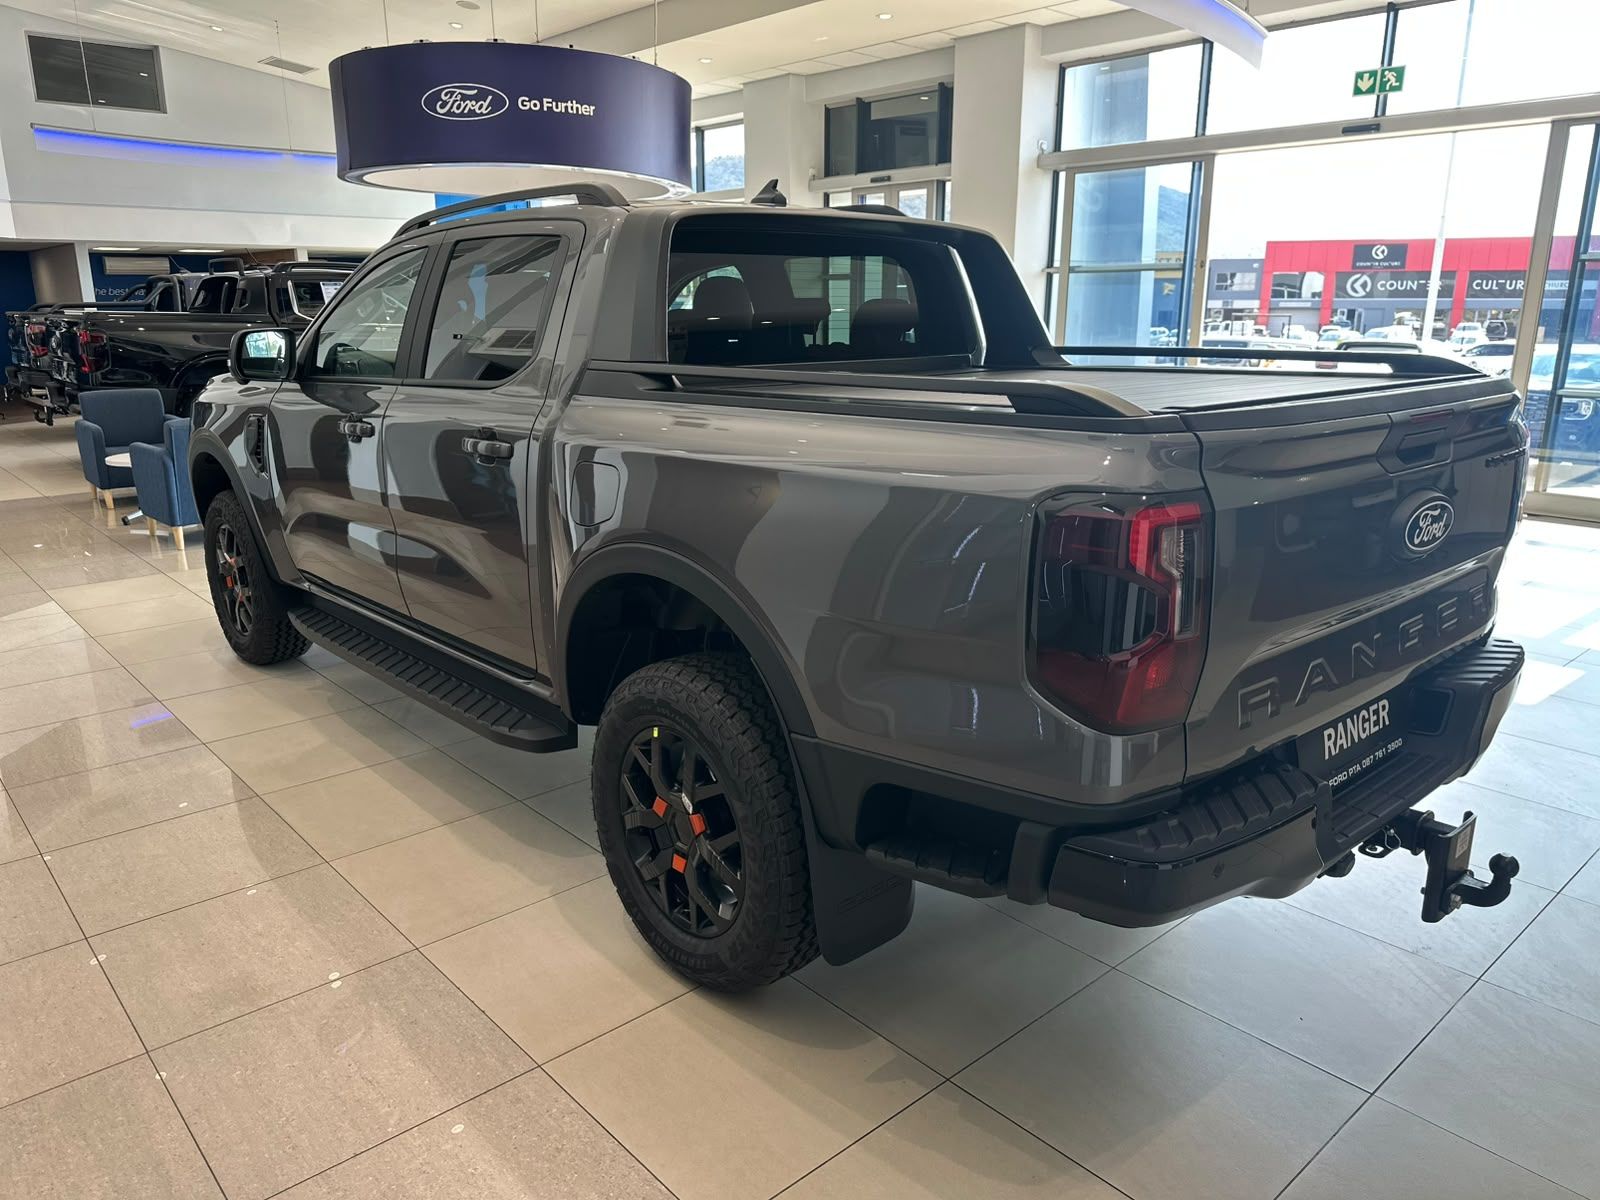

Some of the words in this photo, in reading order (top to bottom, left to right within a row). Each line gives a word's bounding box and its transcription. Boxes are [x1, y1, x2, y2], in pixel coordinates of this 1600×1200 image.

[436, 88, 493, 114] Ford
[518, 96, 541, 111] Go
[543, 98, 596, 116] Further
[1472, 279, 1525, 290] CULTUR
[1414, 508, 1448, 545] Ford
[1237, 583, 1487, 730] RANGER
[1323, 699, 1390, 760] RANGER
[1328, 771, 1348, 787] FORD
[1348, 763, 1361, 777] PTA
